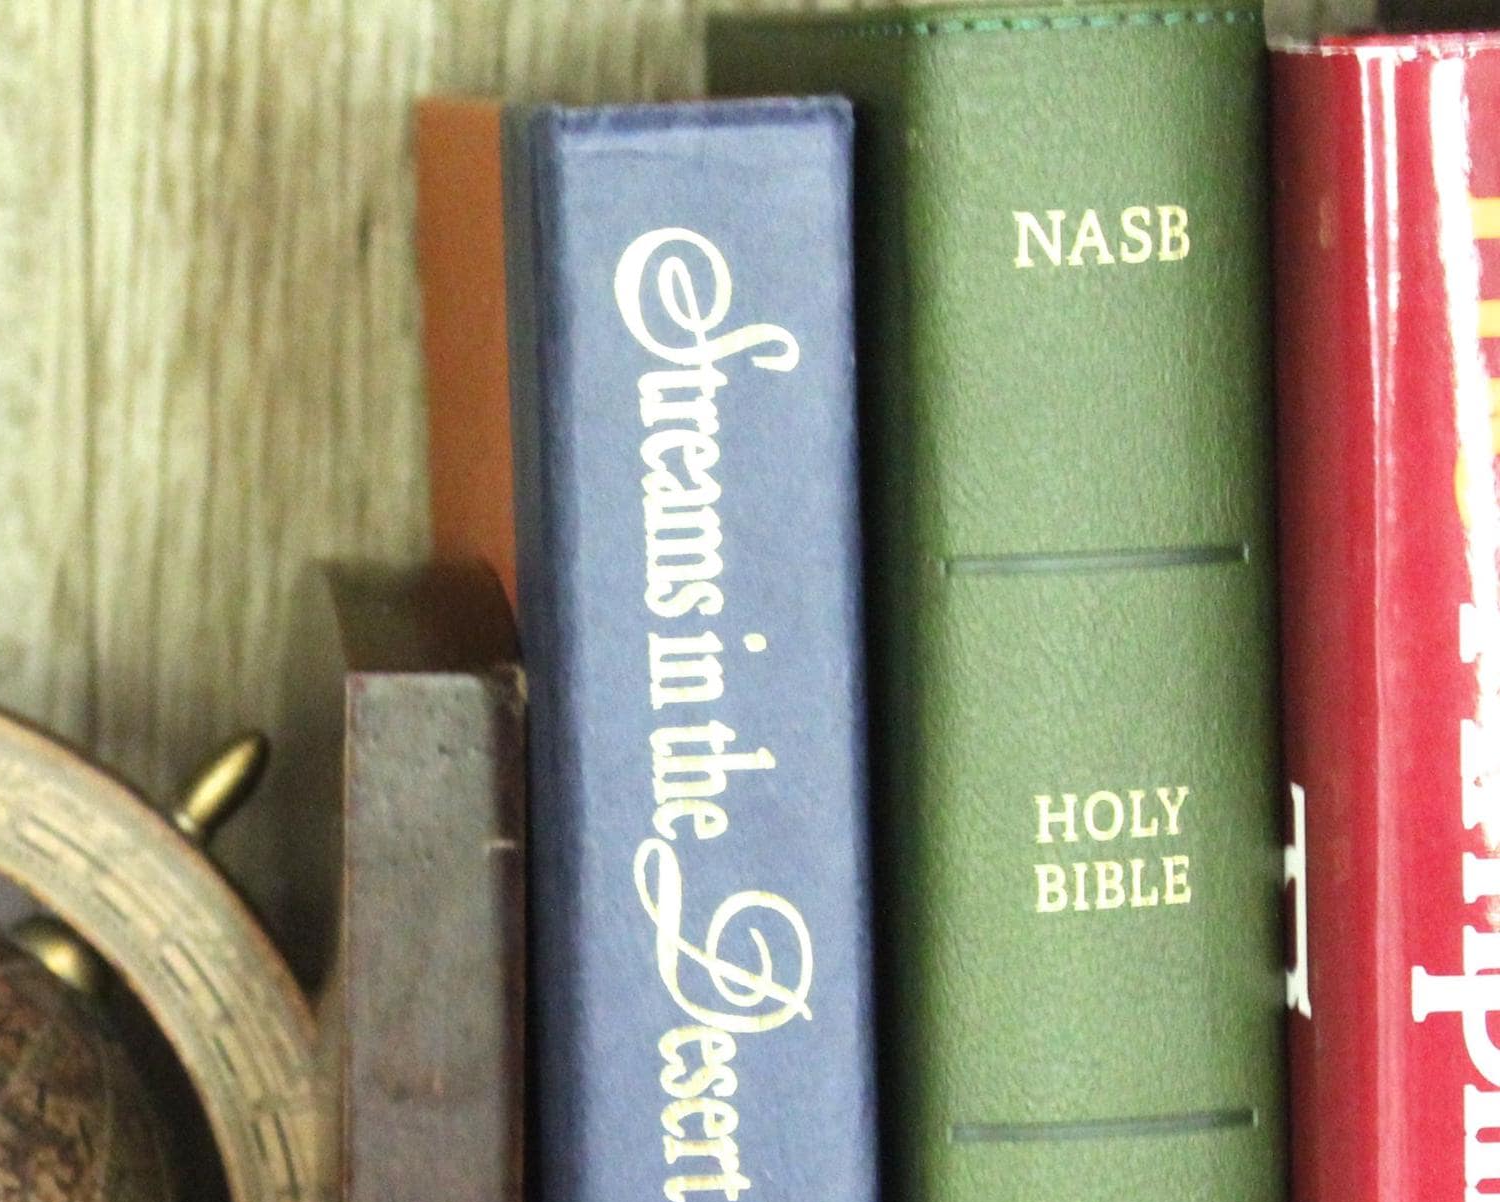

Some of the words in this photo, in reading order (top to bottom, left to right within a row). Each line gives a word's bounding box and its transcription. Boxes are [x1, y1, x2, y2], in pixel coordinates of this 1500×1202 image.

[1012, 205, 1191, 268] NASB
[613, 226, 801, 619] Streams
[647, 631, 768, 711] in
[648, 719, 777, 841] the
[1033, 785, 1190, 844] HOLY
[1033, 854, 1192, 913] BIBLE
